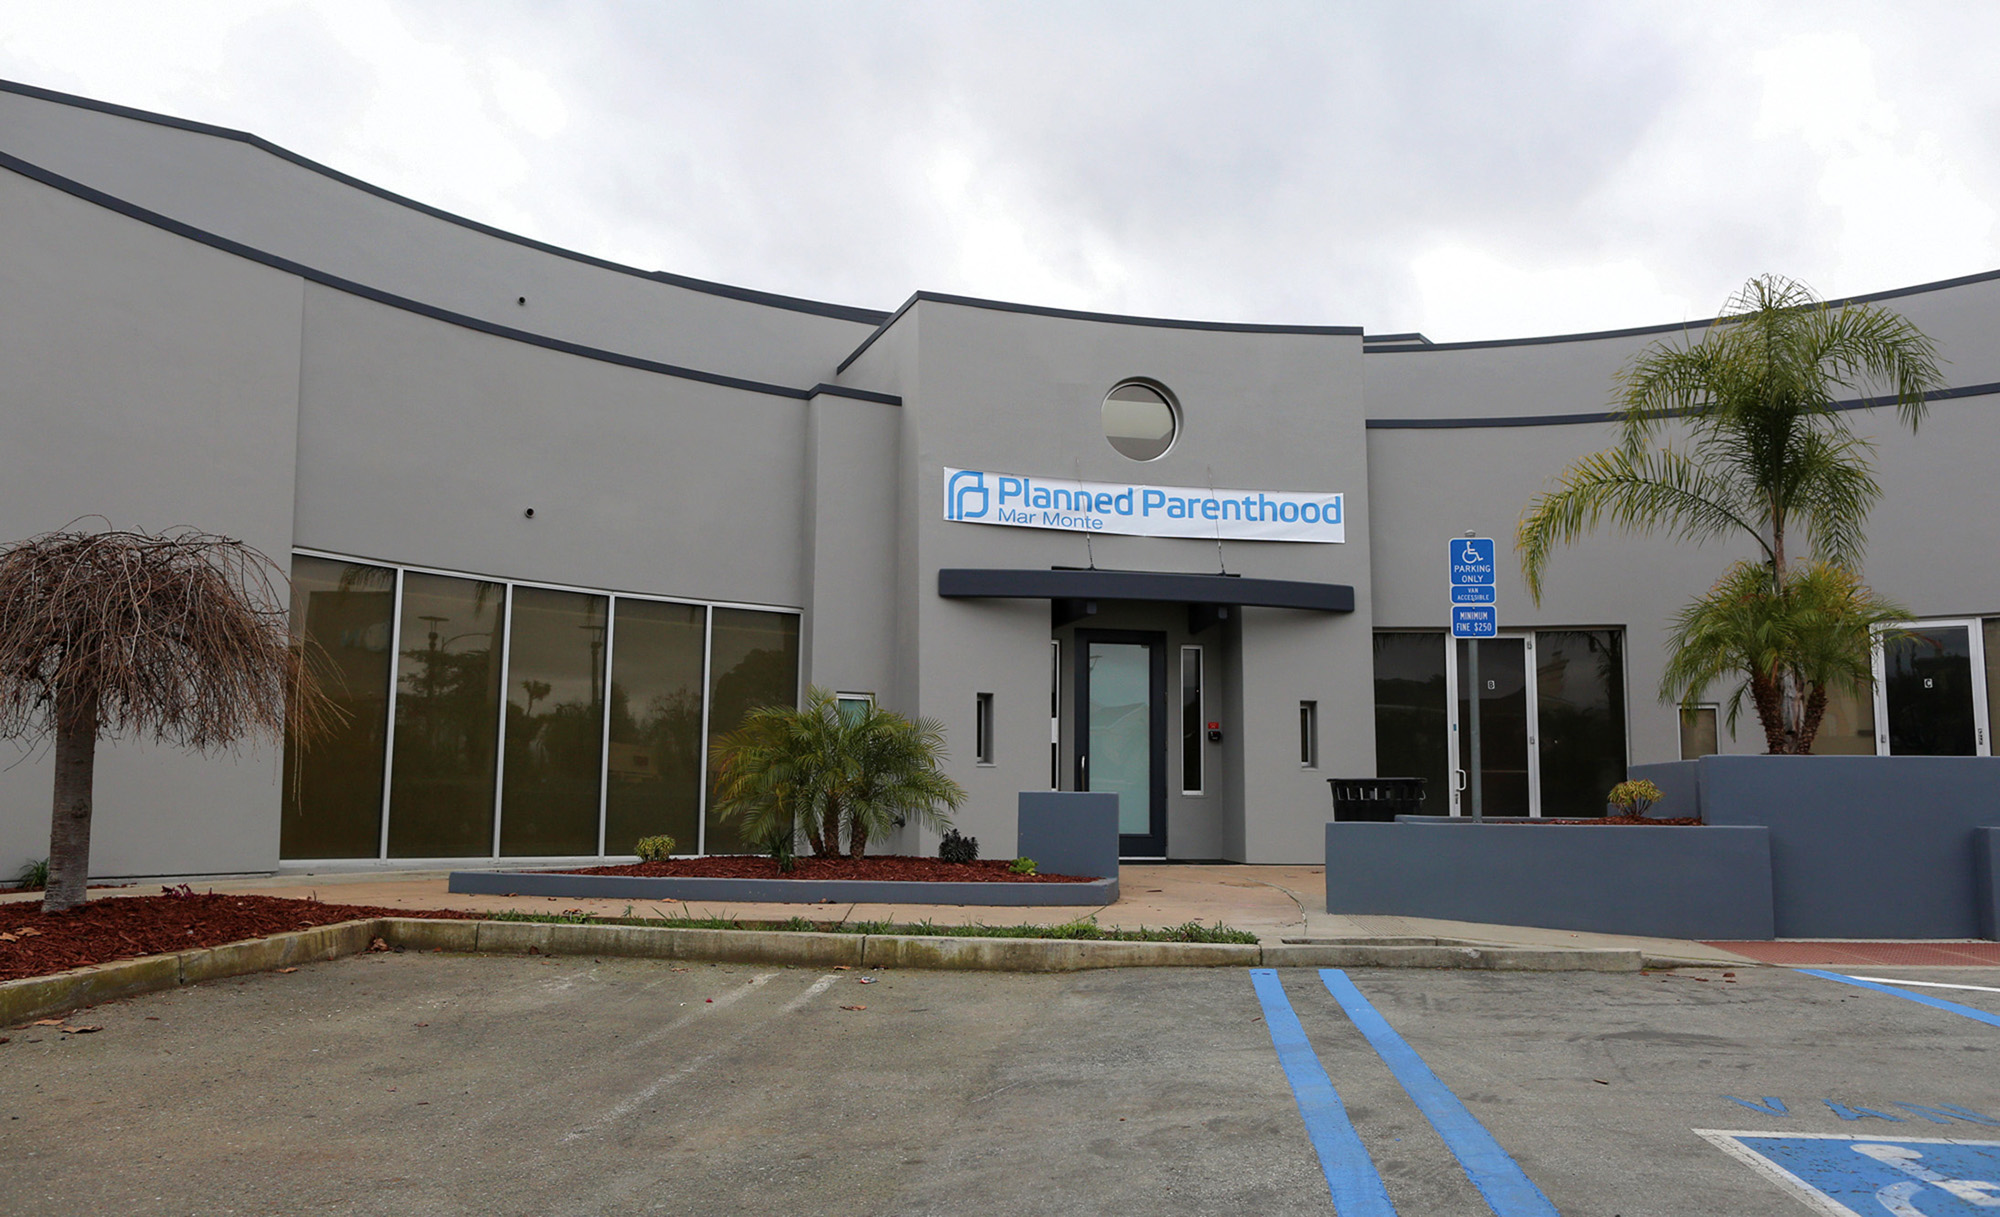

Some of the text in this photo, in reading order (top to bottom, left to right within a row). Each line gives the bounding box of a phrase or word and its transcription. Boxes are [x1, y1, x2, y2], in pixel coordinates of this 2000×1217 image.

[999, 476, 1342, 525] Planned Parenthood
[998, 508, 1103, 530] Mar Monte
[1455, 565, 1491, 573] PARKING
[1462, 575, 1484, 583] ONLY
[1460, 611, 1488, 620] MINIMUM
[1456, 622, 1492, 632] FINE $250
